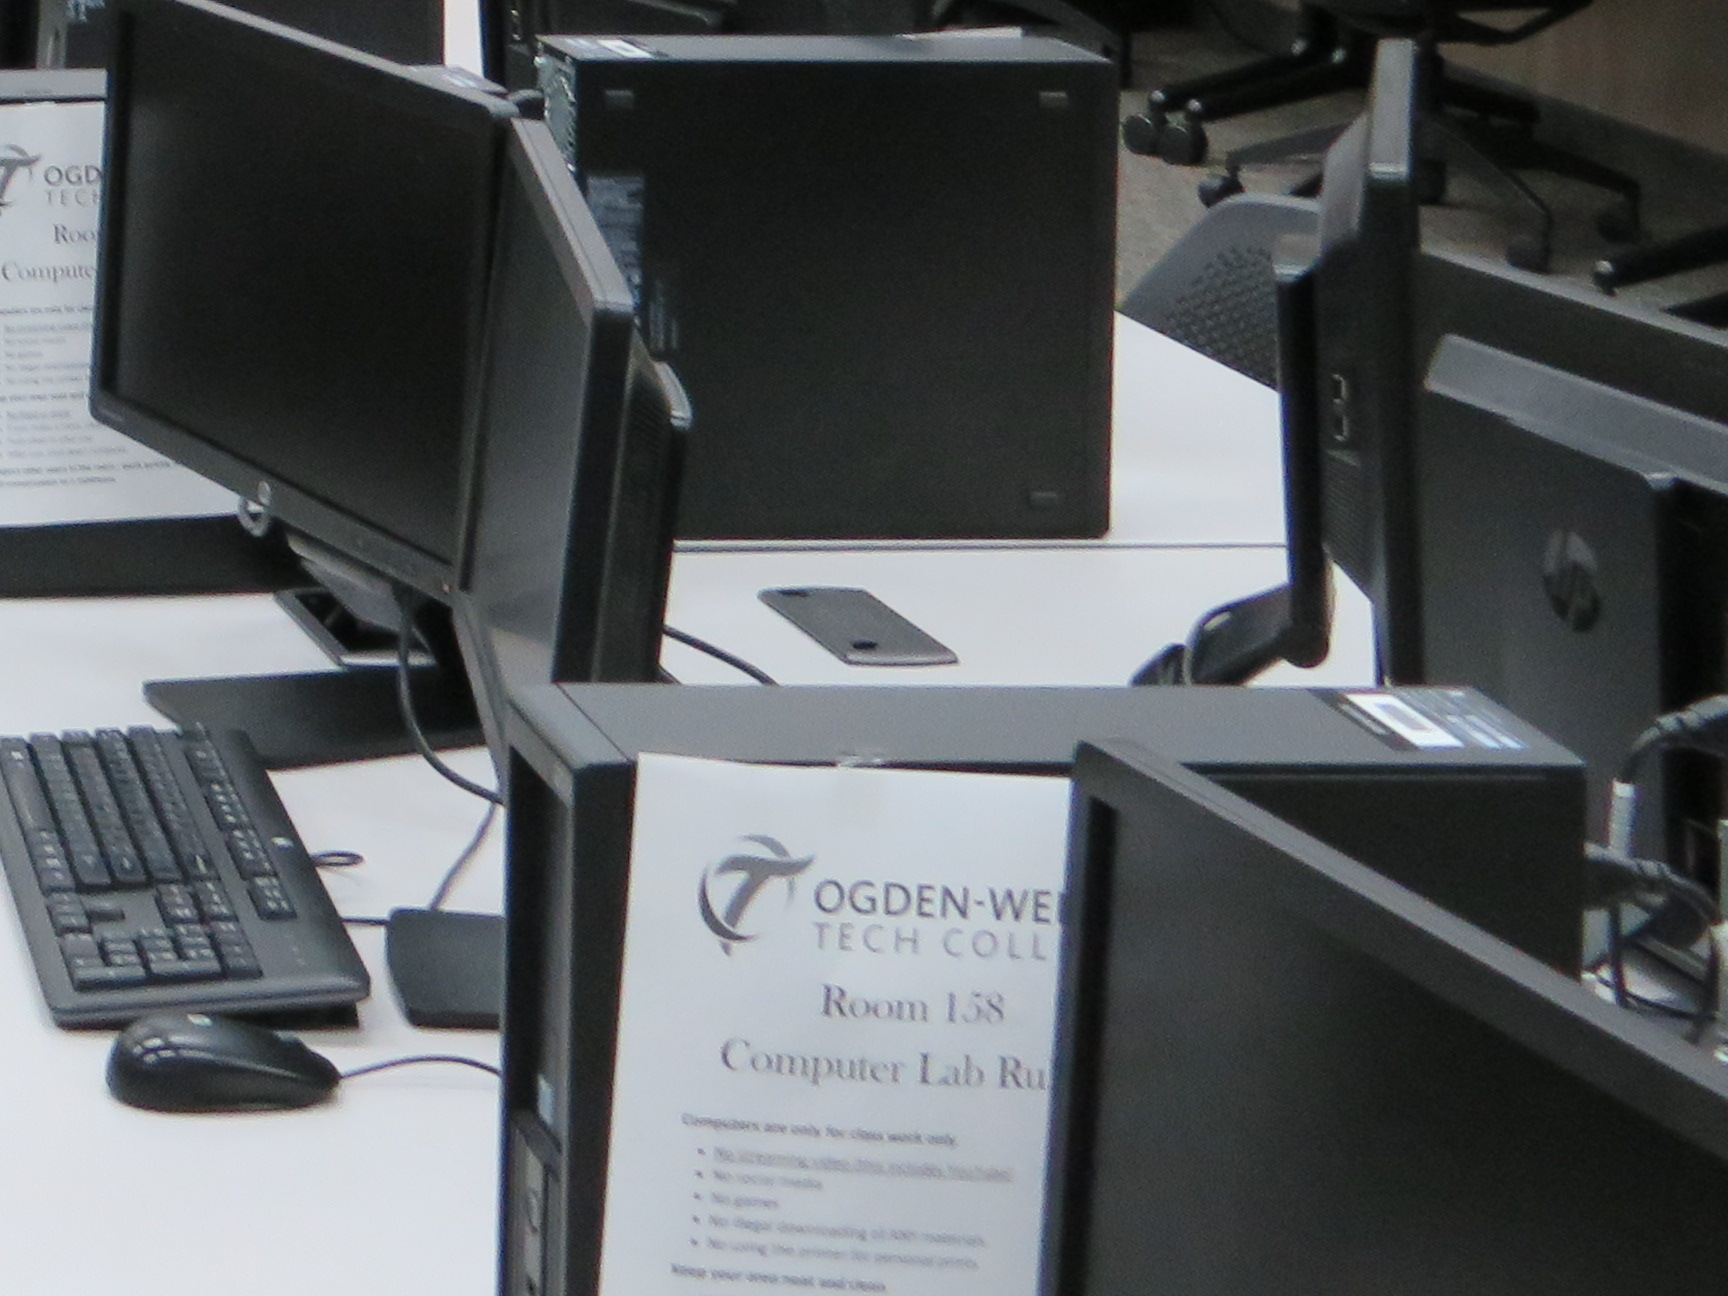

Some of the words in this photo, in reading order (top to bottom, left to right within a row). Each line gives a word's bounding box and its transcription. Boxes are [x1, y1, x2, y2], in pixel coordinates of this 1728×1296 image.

[813, 878, 1062, 926] OGDEN-WE
[812, 920, 921, 955] TECH
[943, 927, 1048, 961] COLL
[820, 982, 929, 1023] Room
[946, 990, 1006, 1025] 158
[719, 1036, 905, 1087] Computer
[918, 1051, 986, 1087] Lab
[998, 1054, 1047, 1092] Ru
